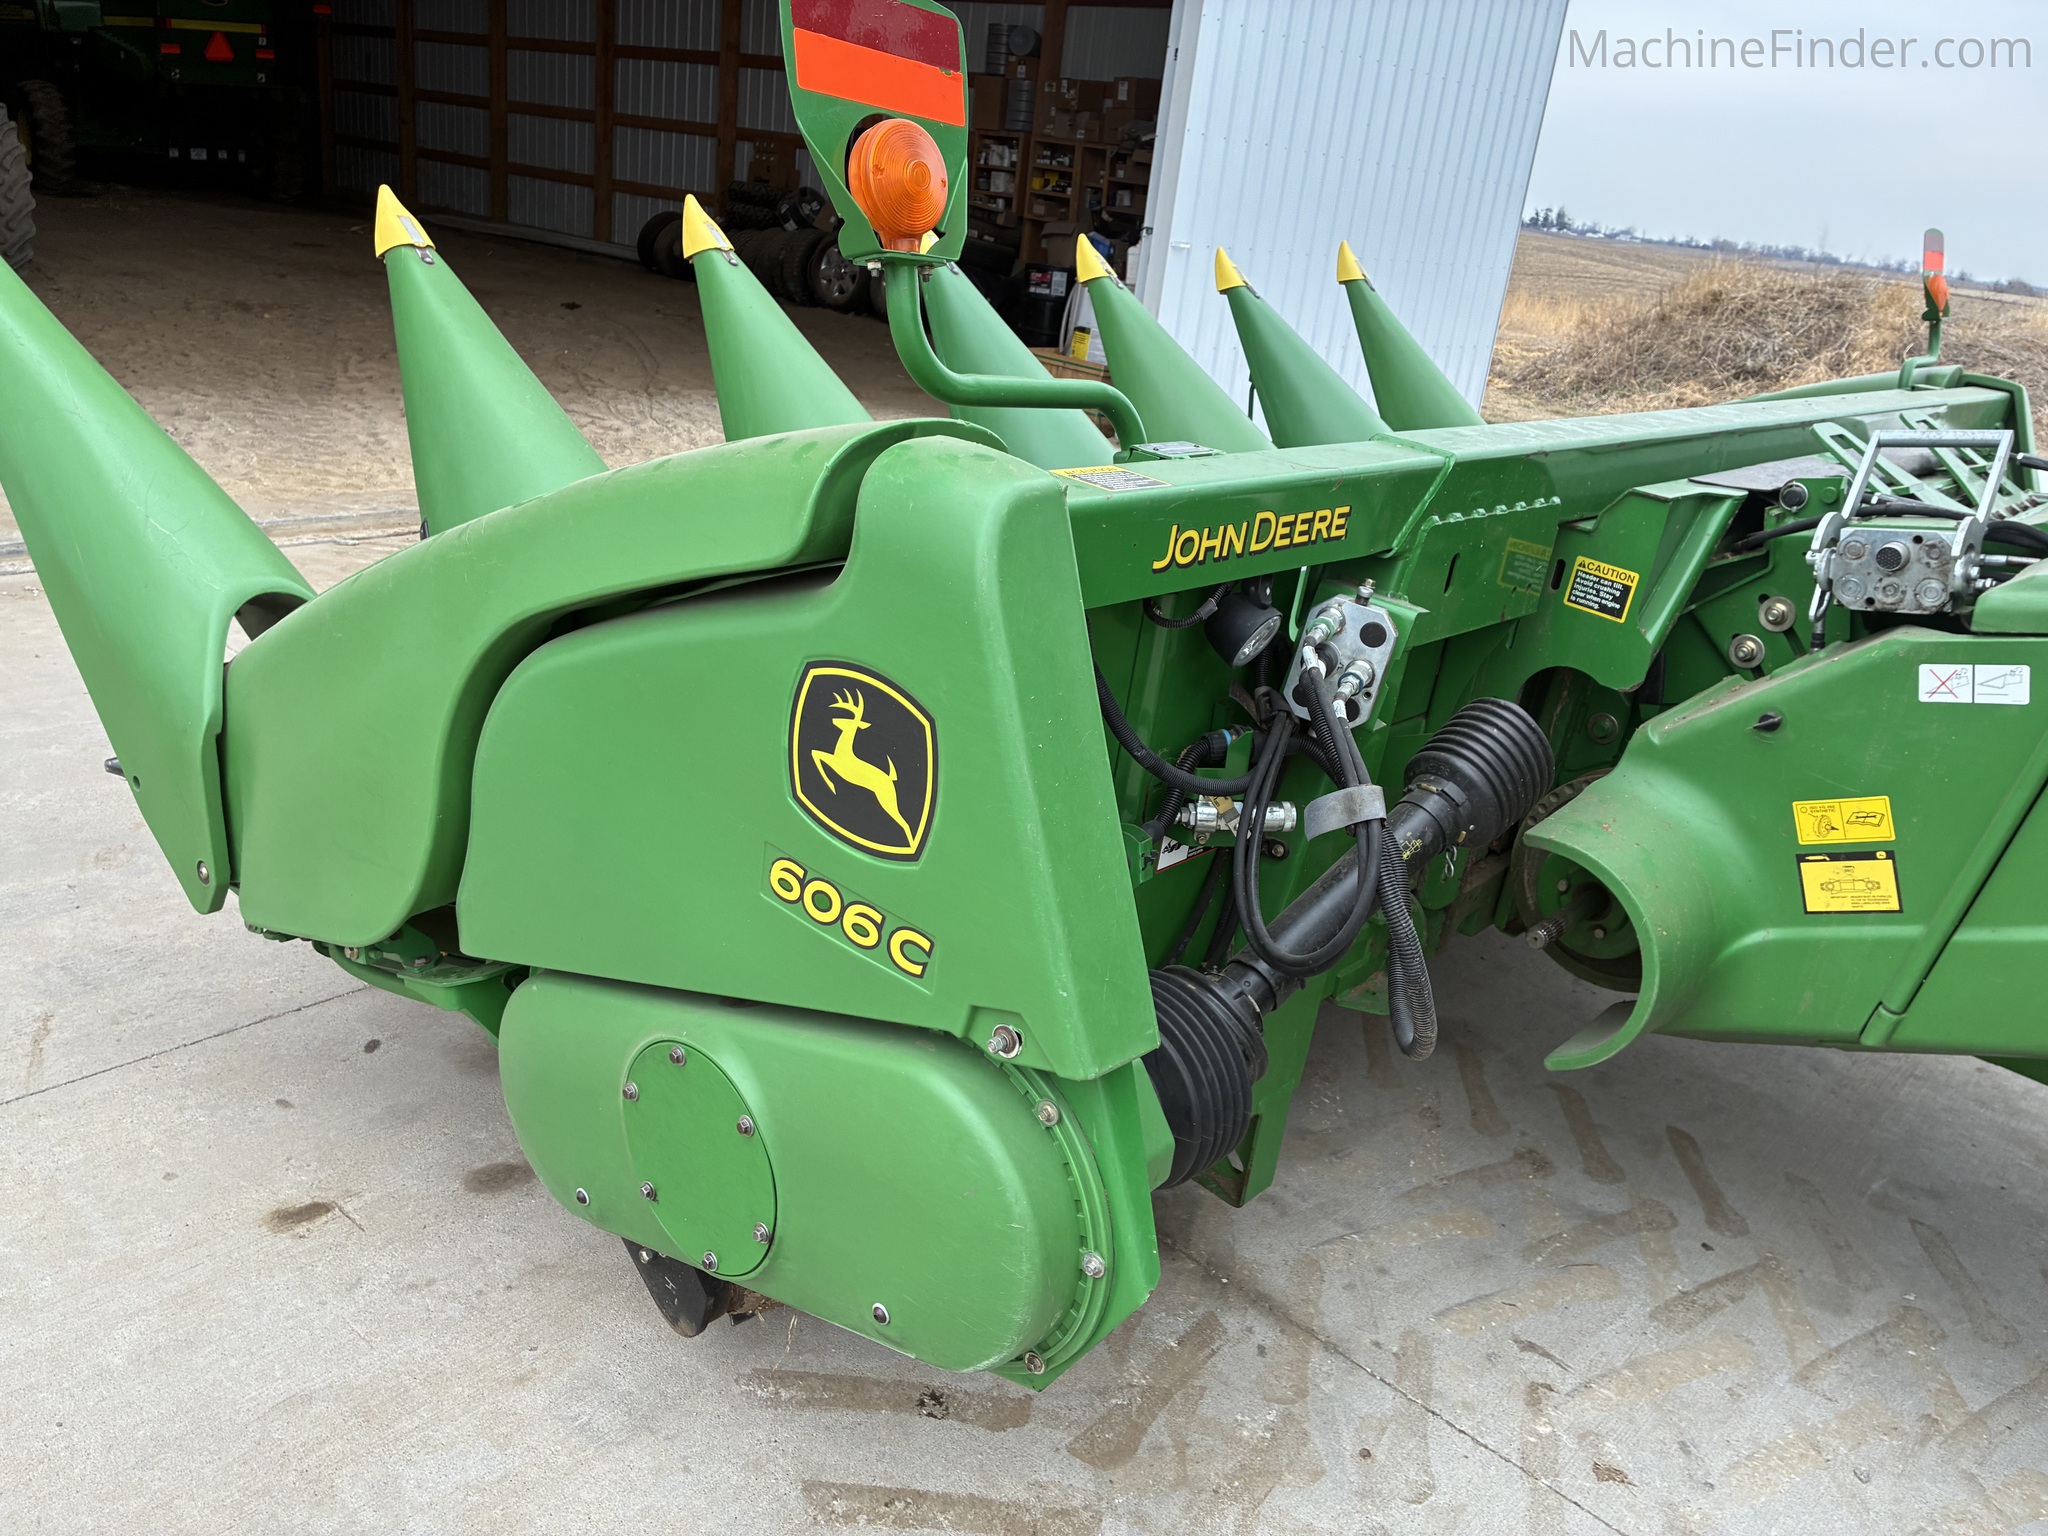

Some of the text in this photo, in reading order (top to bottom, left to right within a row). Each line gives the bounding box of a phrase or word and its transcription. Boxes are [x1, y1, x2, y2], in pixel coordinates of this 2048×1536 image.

[1151, 504, 1353, 574] JOHN DEERE
[1577, 571, 1600, 582] Header
[1613, 581, 1624, 590] tilt.
[1587, 561, 1636, 584] CAUTION
[1575, 577, 1621, 597] Avoid crushing
[1599, 591, 1614, 600] Stay
[1576, 597, 1600, 609] running.
[1586, 593, 1601, 602] when
[1601, 599, 1621, 609] engine
